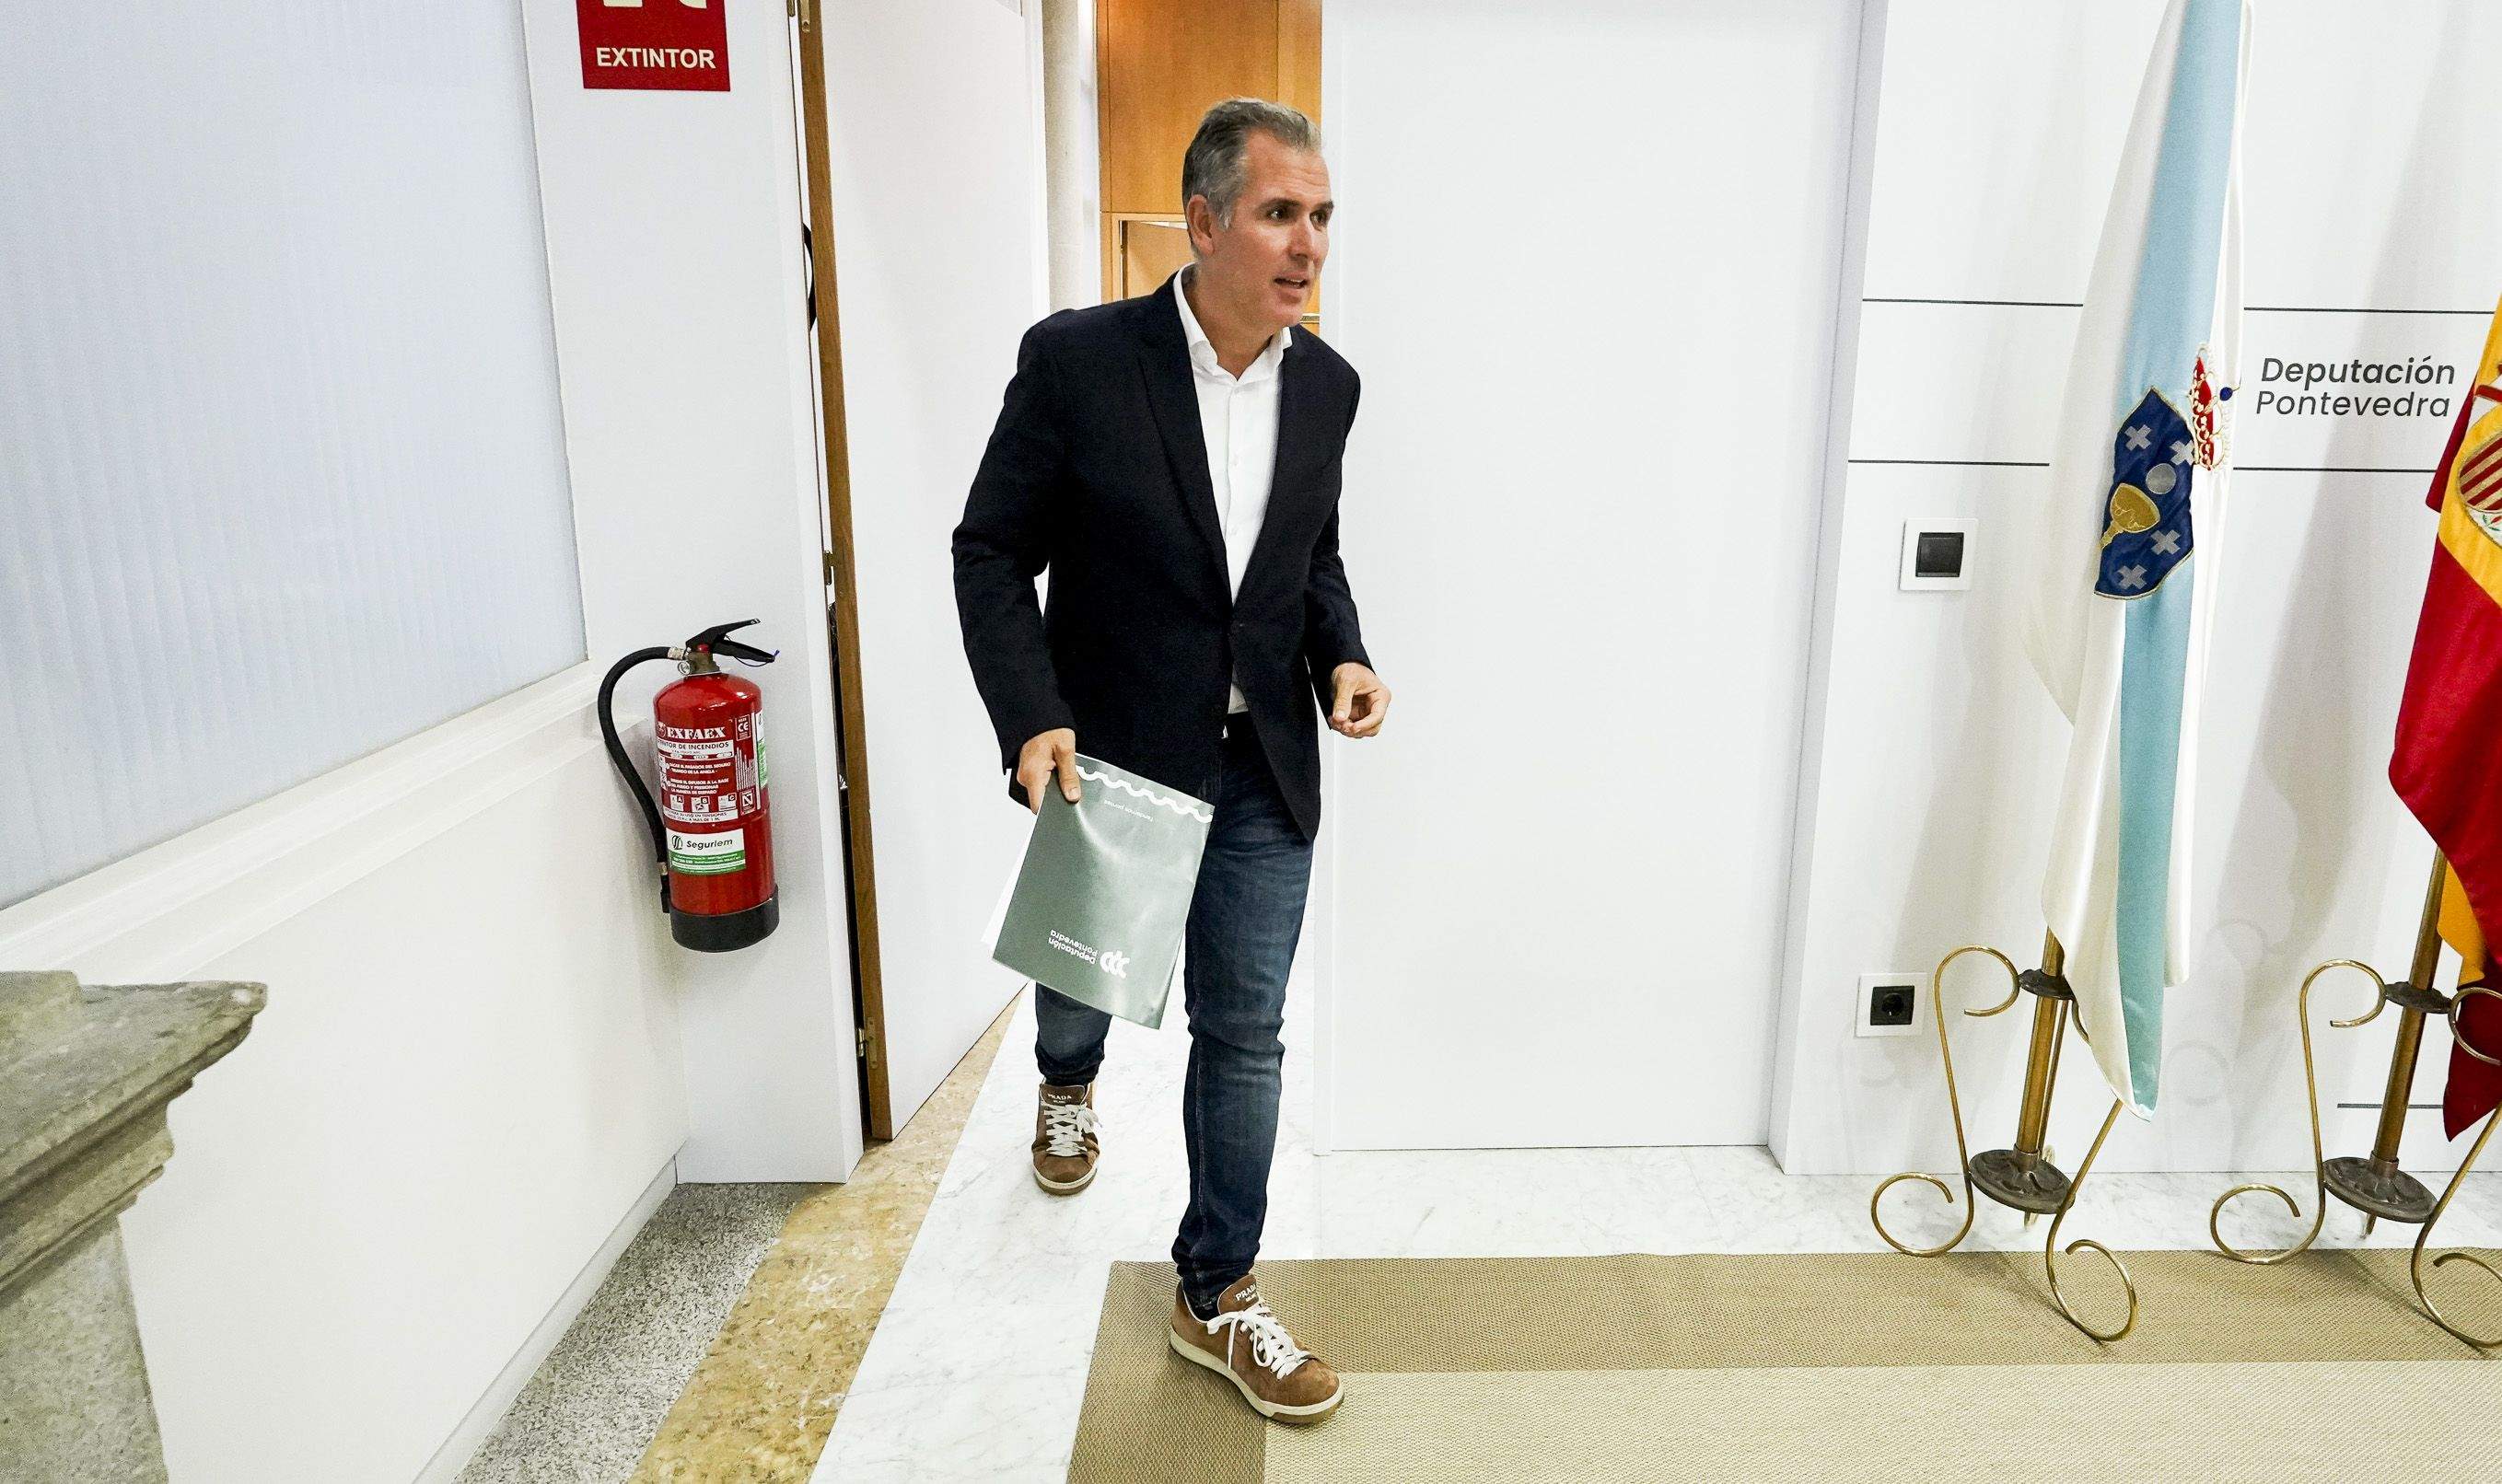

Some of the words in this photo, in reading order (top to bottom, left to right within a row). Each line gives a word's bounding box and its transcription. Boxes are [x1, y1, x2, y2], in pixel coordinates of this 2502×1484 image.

[596, 47, 716, 69] EXTINTOR
[2261, 355, 2455, 390] Deputación
[2256, 390, 2450, 417] Pontevedra
[667, 726, 726, 740] EXFAEX
[689, 742, 729, 750] INCENDIOS
[1048, 937, 1096, 965] Deputación
[1050, 929, 1099, 956] Pontevedra
